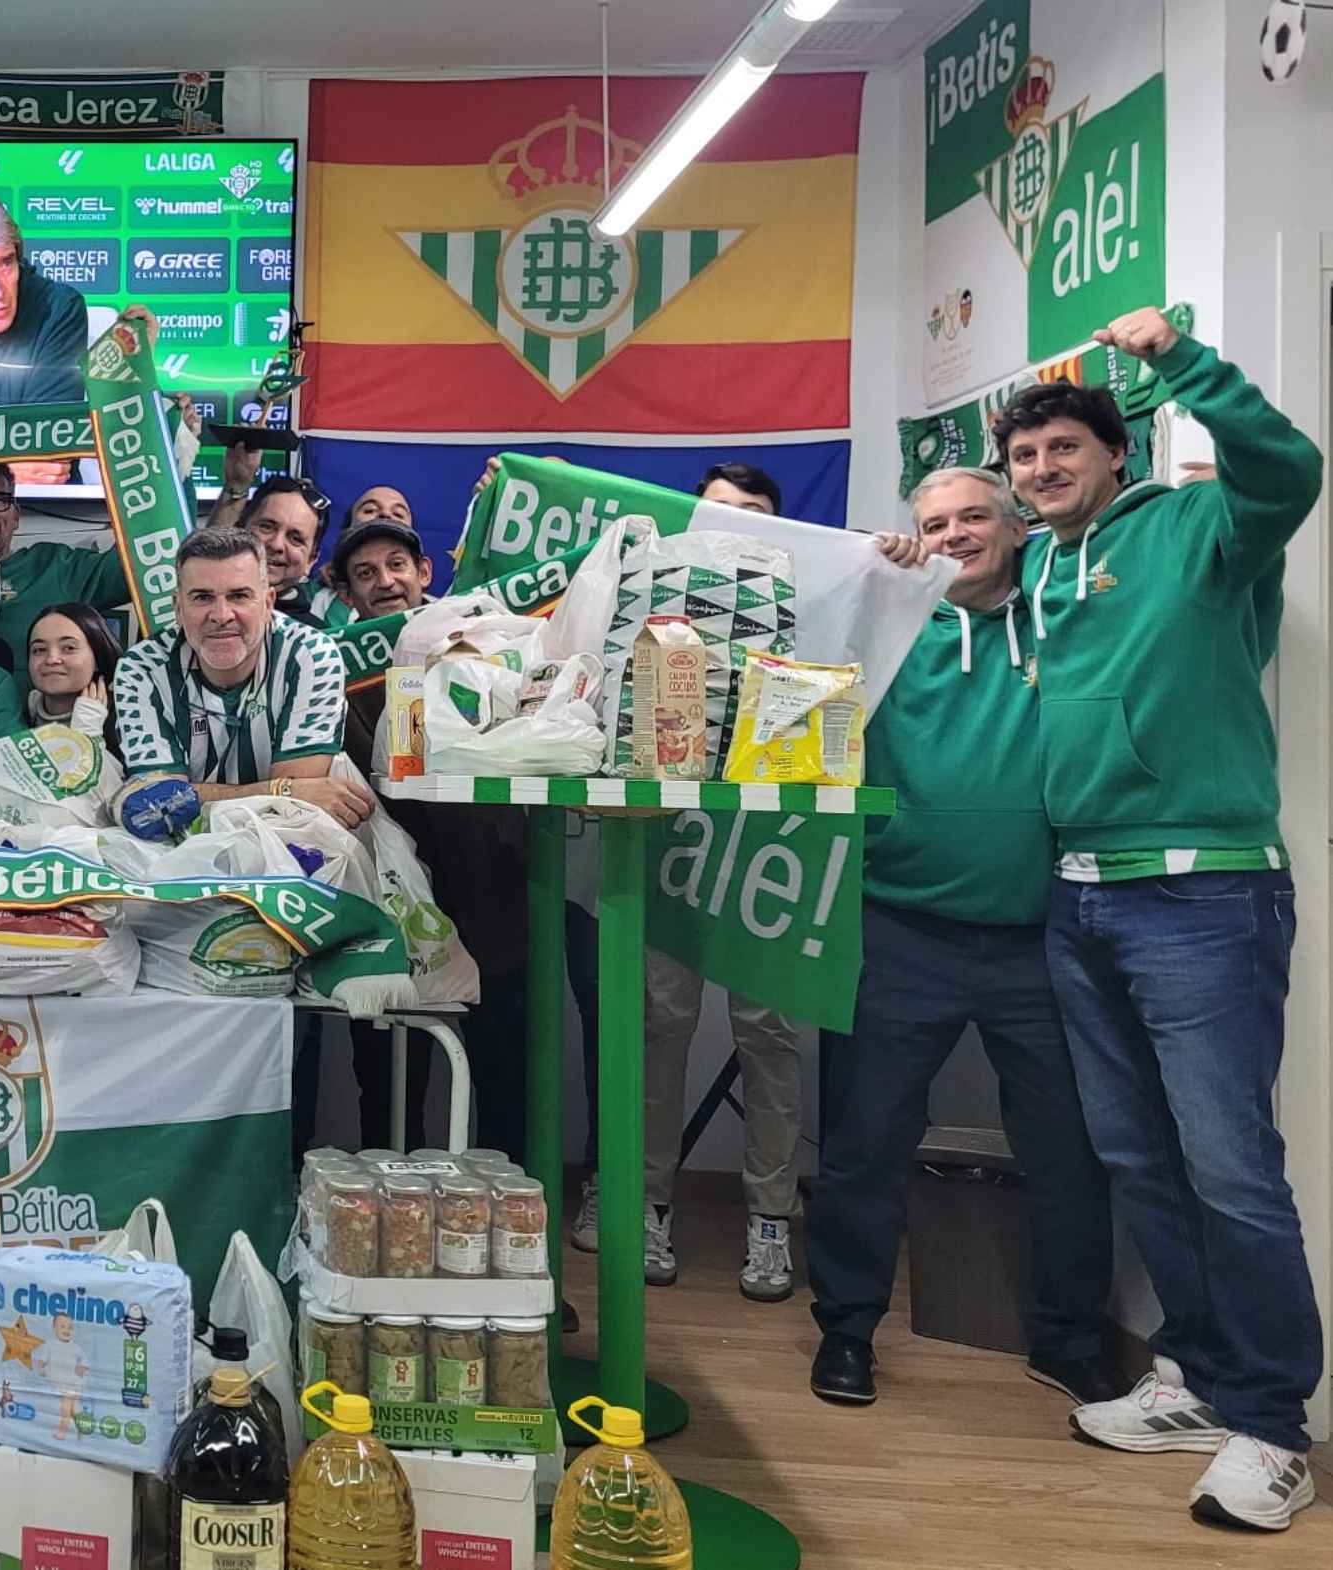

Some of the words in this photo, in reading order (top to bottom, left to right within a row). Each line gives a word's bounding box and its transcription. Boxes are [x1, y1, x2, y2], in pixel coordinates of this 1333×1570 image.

[53, 89, 159, 125] Jerez
[145, 153, 216, 172] LALIGA
[27, 197, 115, 212] REVEL
[157, 198, 223, 215] hummel
[1052, 142, 1140, 298] alé!
[159, 253, 225, 269] GREE
[103, 396, 156, 518] Peña
[660, 809, 850, 958] alé!
[13, 1283, 126, 1327] chelino
[134, 1346, 145, 1362] 6
[519, 1428, 535, 1441] 12
